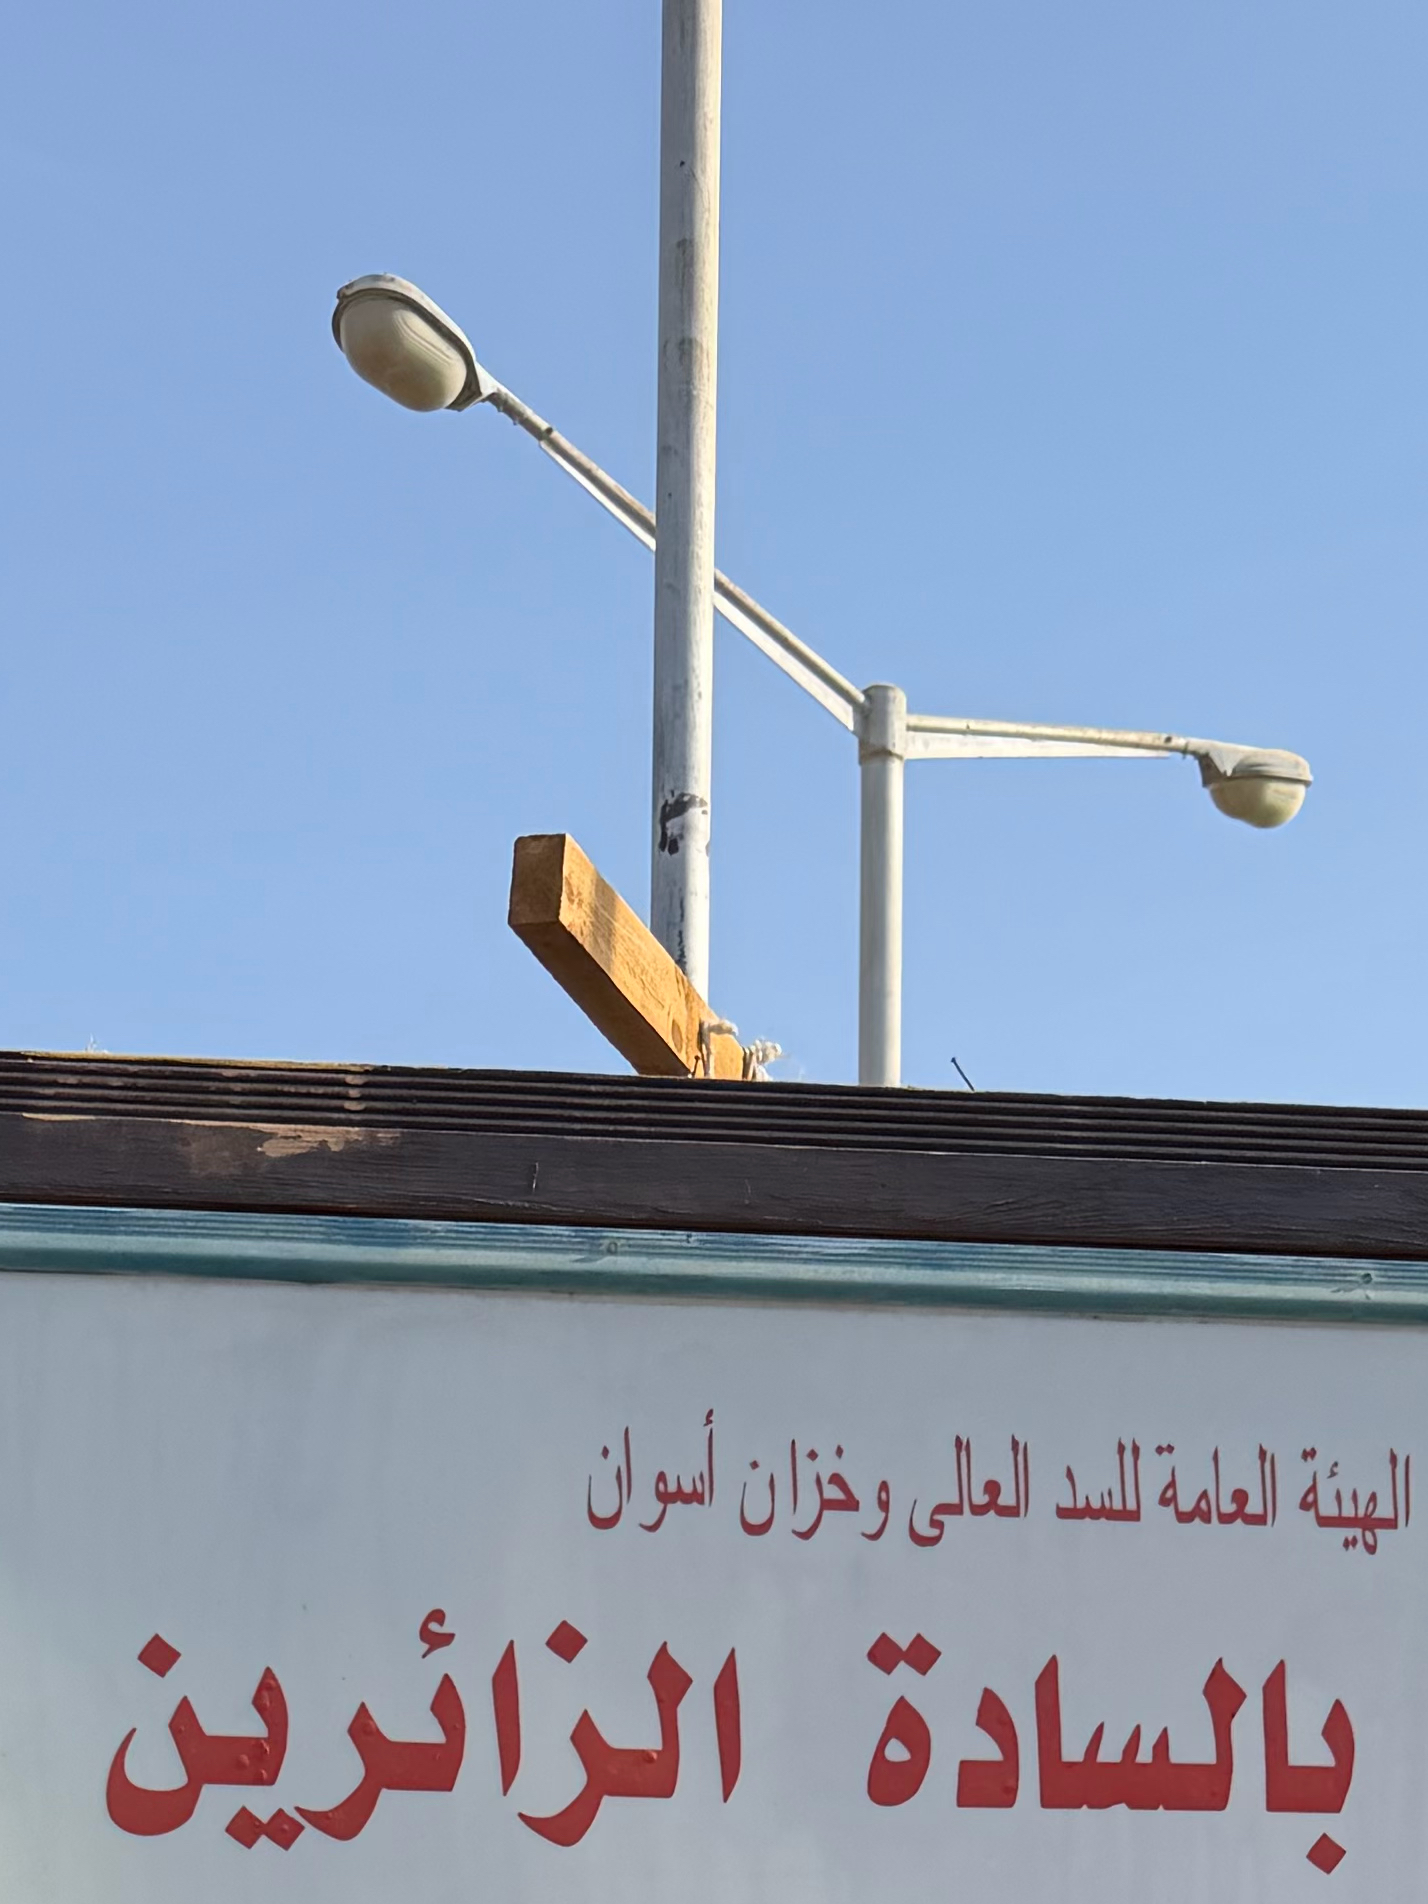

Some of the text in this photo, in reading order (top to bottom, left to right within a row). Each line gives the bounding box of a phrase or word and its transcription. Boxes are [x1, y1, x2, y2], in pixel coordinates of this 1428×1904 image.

[586, 1407, 715, 1534] أسوان
[1055, 1436, 1142, 1523] للسد
[1155, 1442, 1276, 1528] العامة
[1298, 1446, 1411, 1556] الهيئة
[106, 1608, 744, 1851] الزائرين
[867, 1633, 1357, 1875] بالسادة
